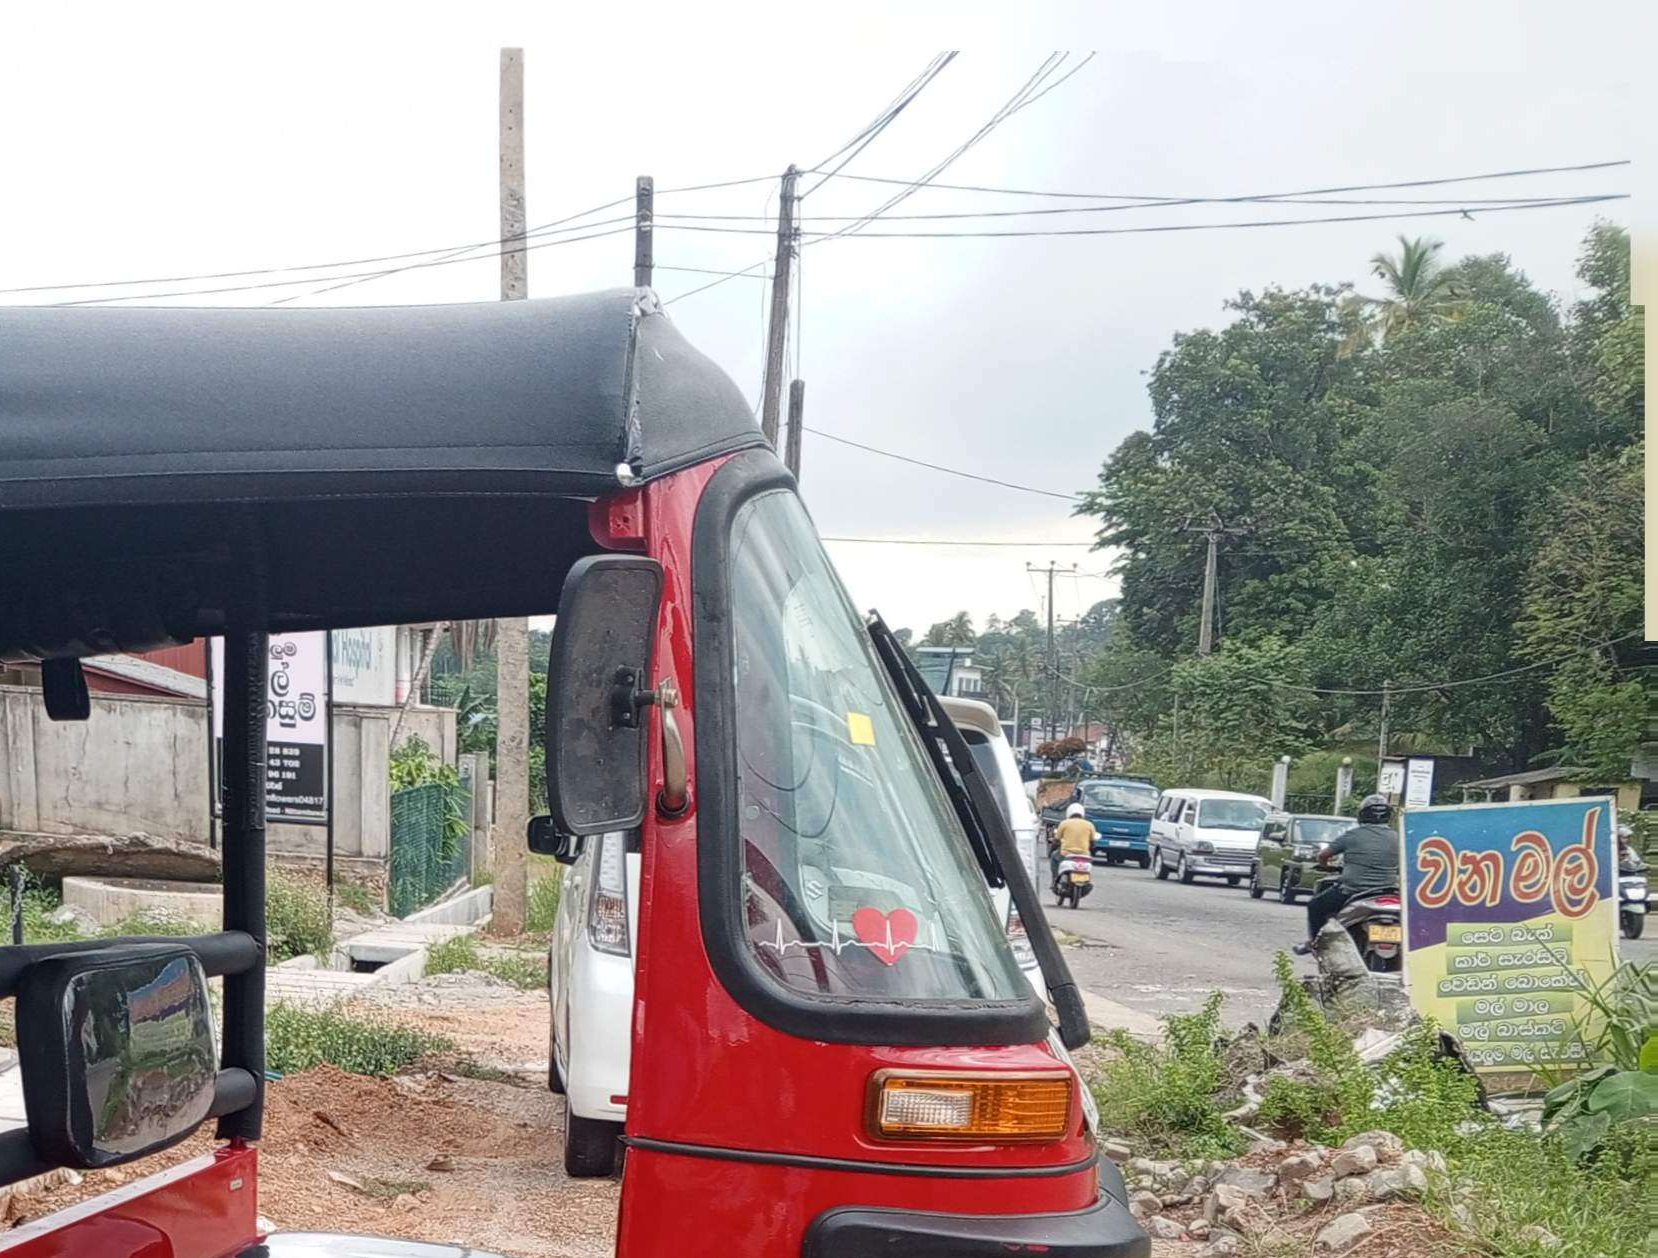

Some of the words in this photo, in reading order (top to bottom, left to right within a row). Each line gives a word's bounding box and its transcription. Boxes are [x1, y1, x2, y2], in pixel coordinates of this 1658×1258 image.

[1510, 806, 1601, 919] මල්
[1474, 998, 1506, 1016] මල්
[1459, 1021, 1490, 1041] මල්
